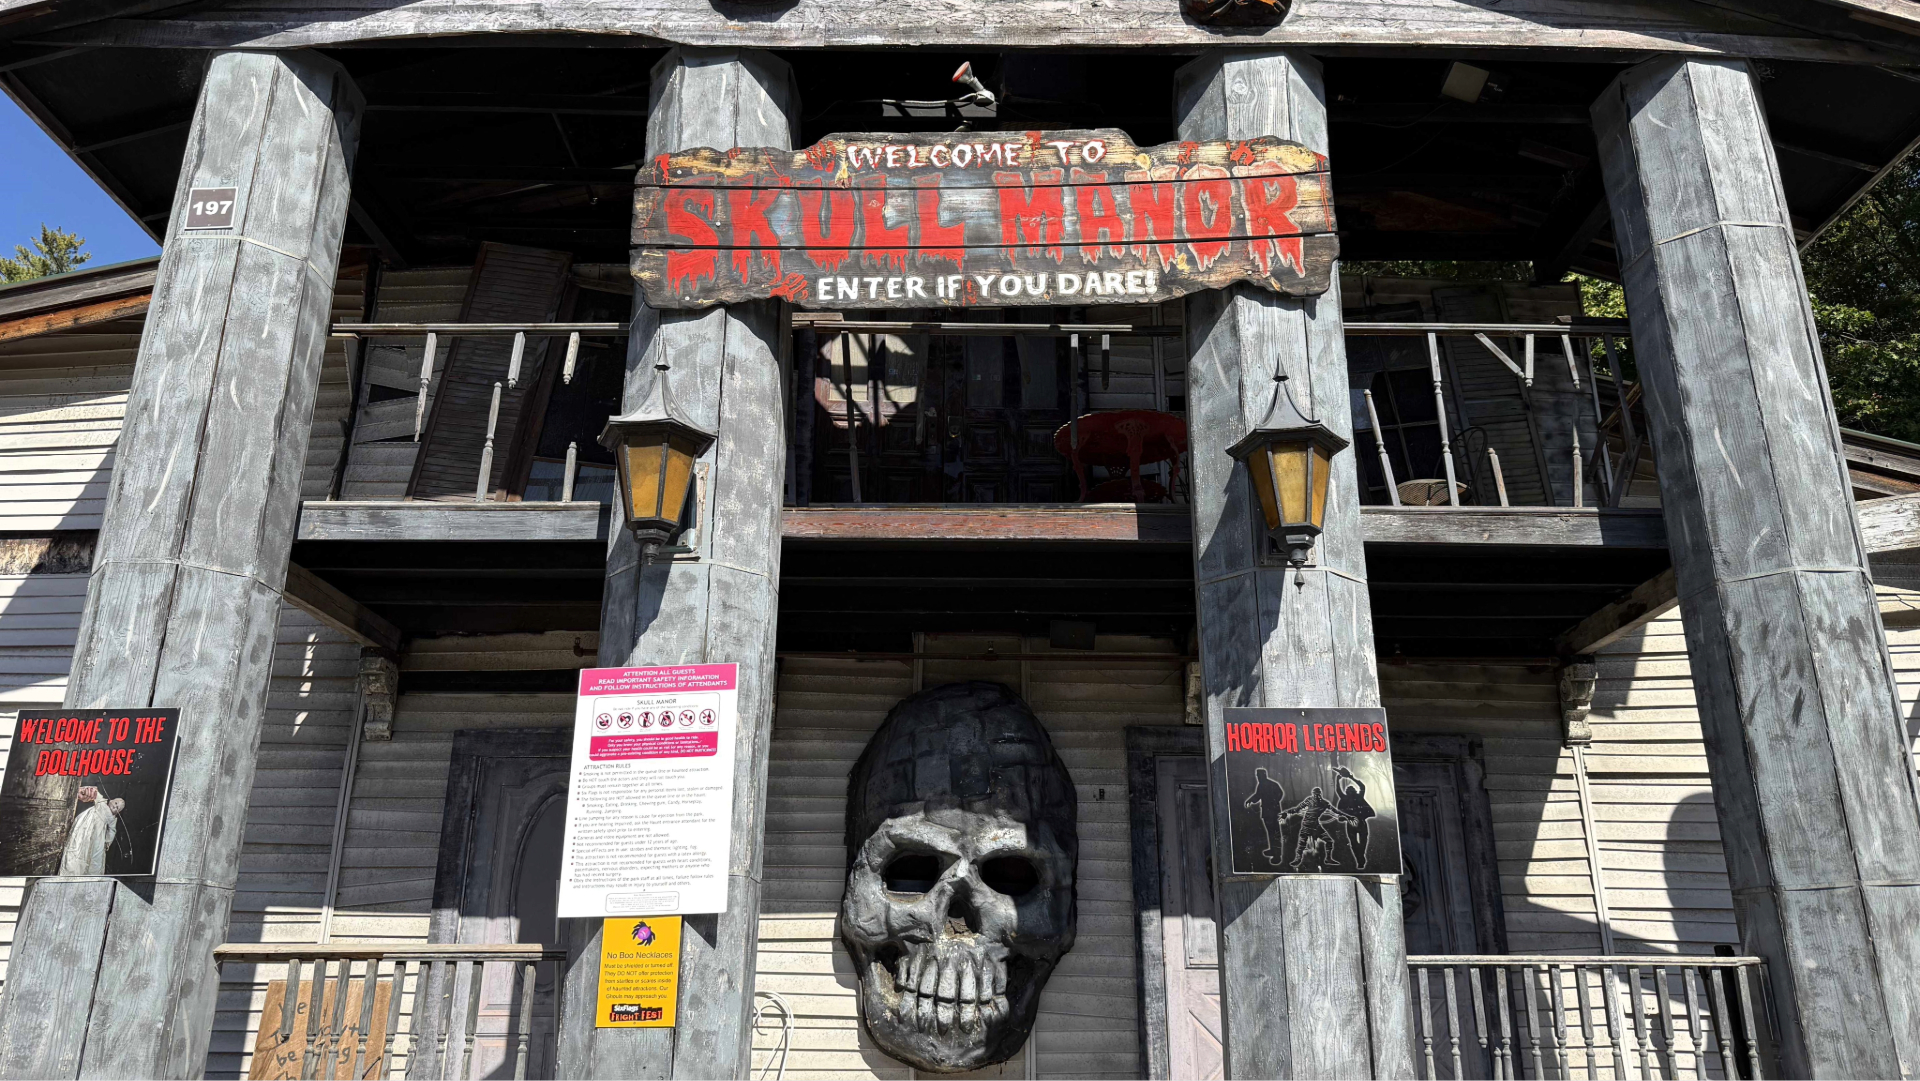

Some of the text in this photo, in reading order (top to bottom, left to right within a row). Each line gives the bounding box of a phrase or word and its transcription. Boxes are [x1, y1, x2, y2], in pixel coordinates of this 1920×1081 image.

[848, 140, 1107, 168] WELCOME TO
[192, 200, 233, 216] 197
[664, 161, 1305, 295] SKULL MANOR
[818, 271, 1157, 301] ENTER IF YOU DARE!
[20, 717, 166, 744] WELCOME TO THE
[1226, 722, 1386, 753] HORROR LEGENDS
[35, 749, 135, 776] DOLLHOUSE
[611, 1011, 662, 1021] FRIGHT FEST
